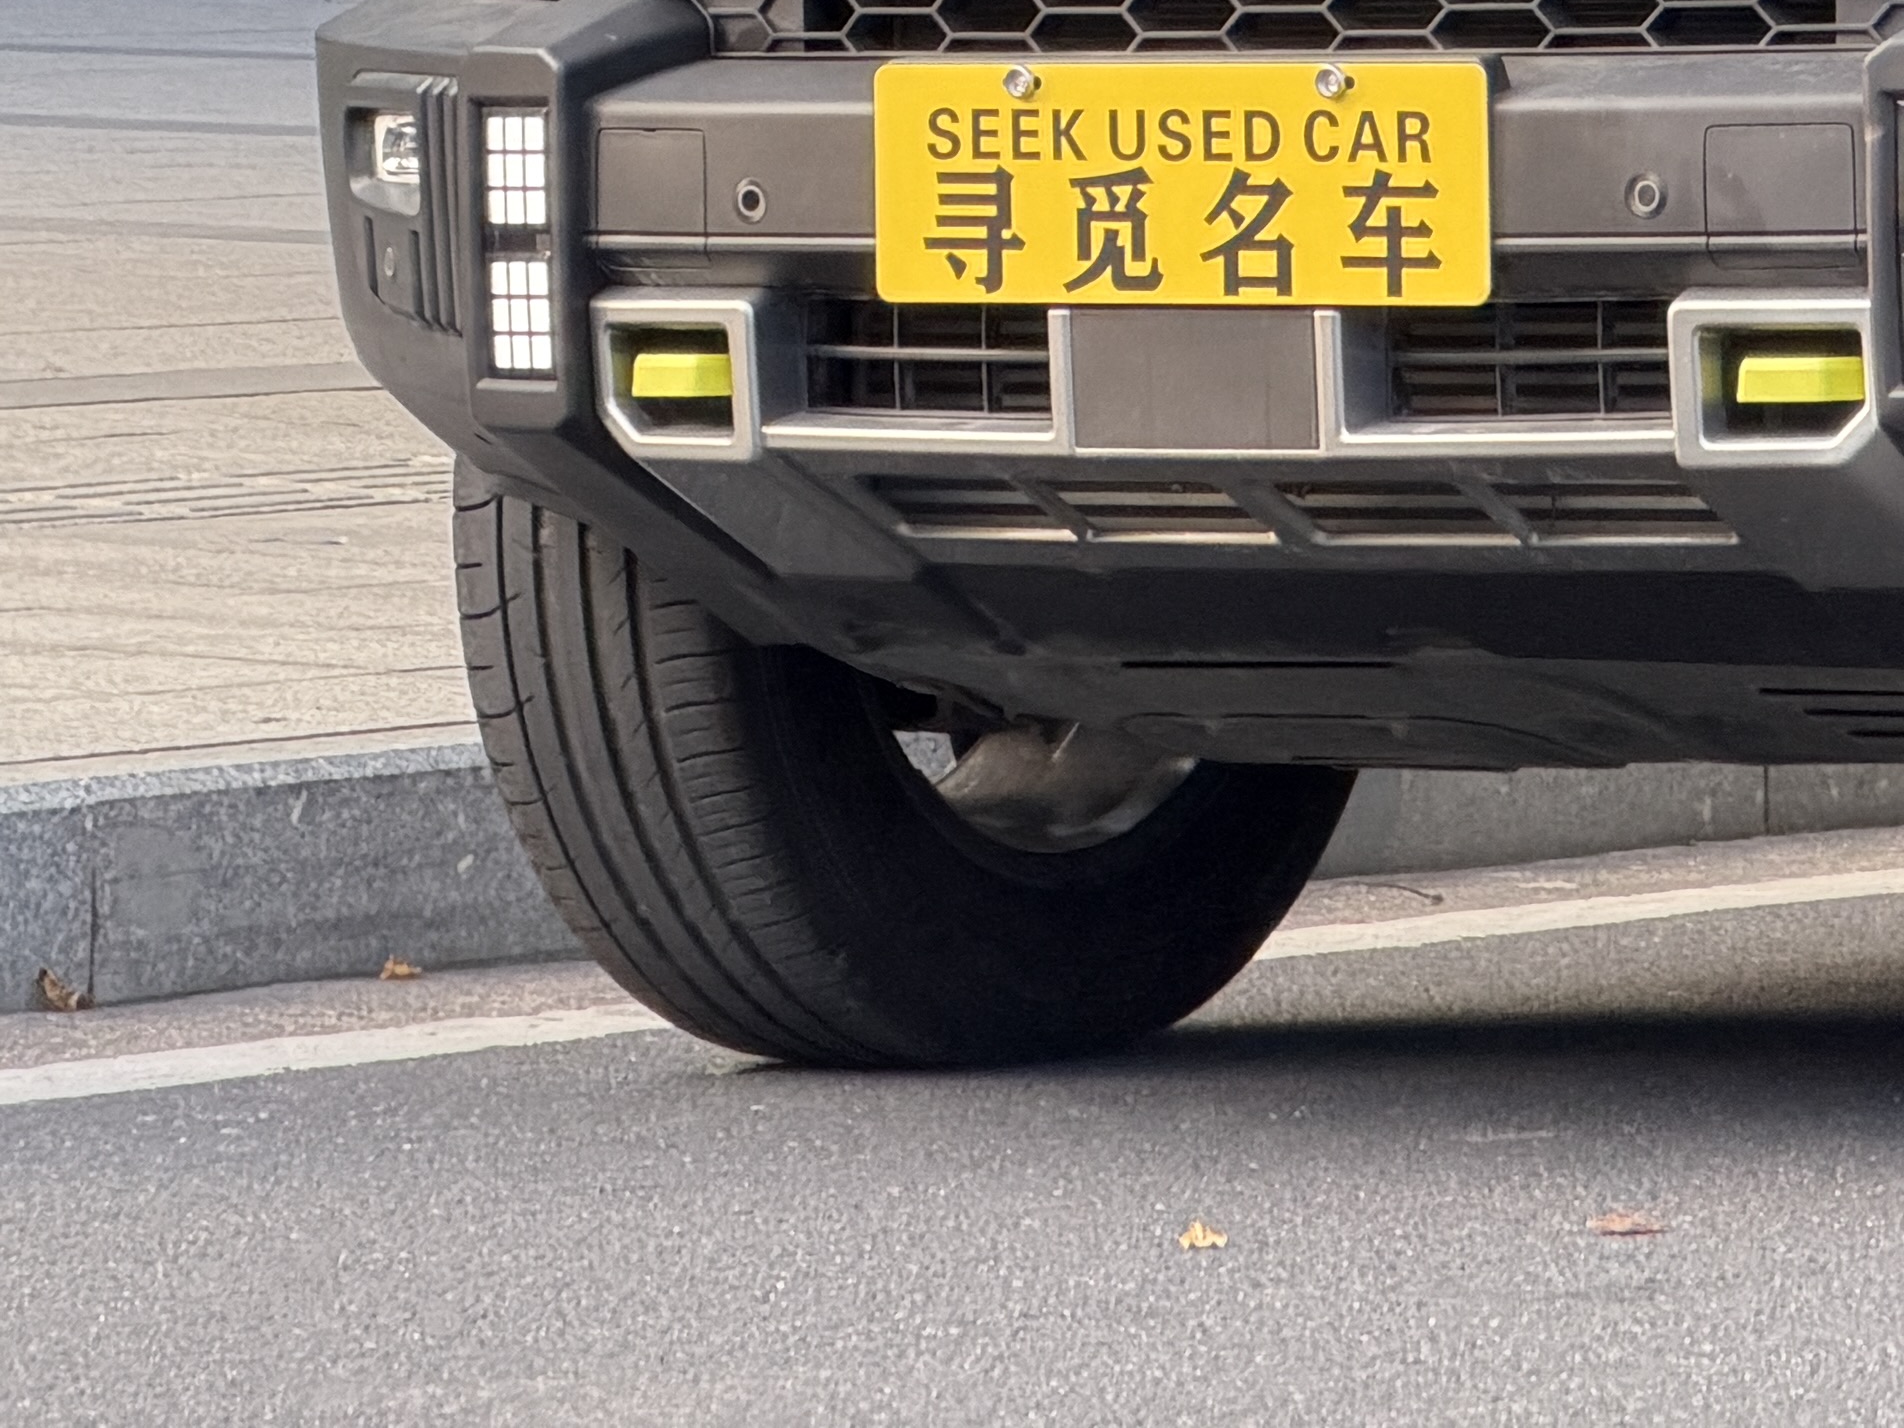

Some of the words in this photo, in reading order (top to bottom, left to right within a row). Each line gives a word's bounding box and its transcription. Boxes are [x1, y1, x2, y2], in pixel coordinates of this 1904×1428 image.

[926, 107, 1088, 161] SEEK
[1108, 108, 1282, 162] USED
[1303, 109, 1434, 164] CAR
[922, 164, 1443, 298] 寻觅名车
